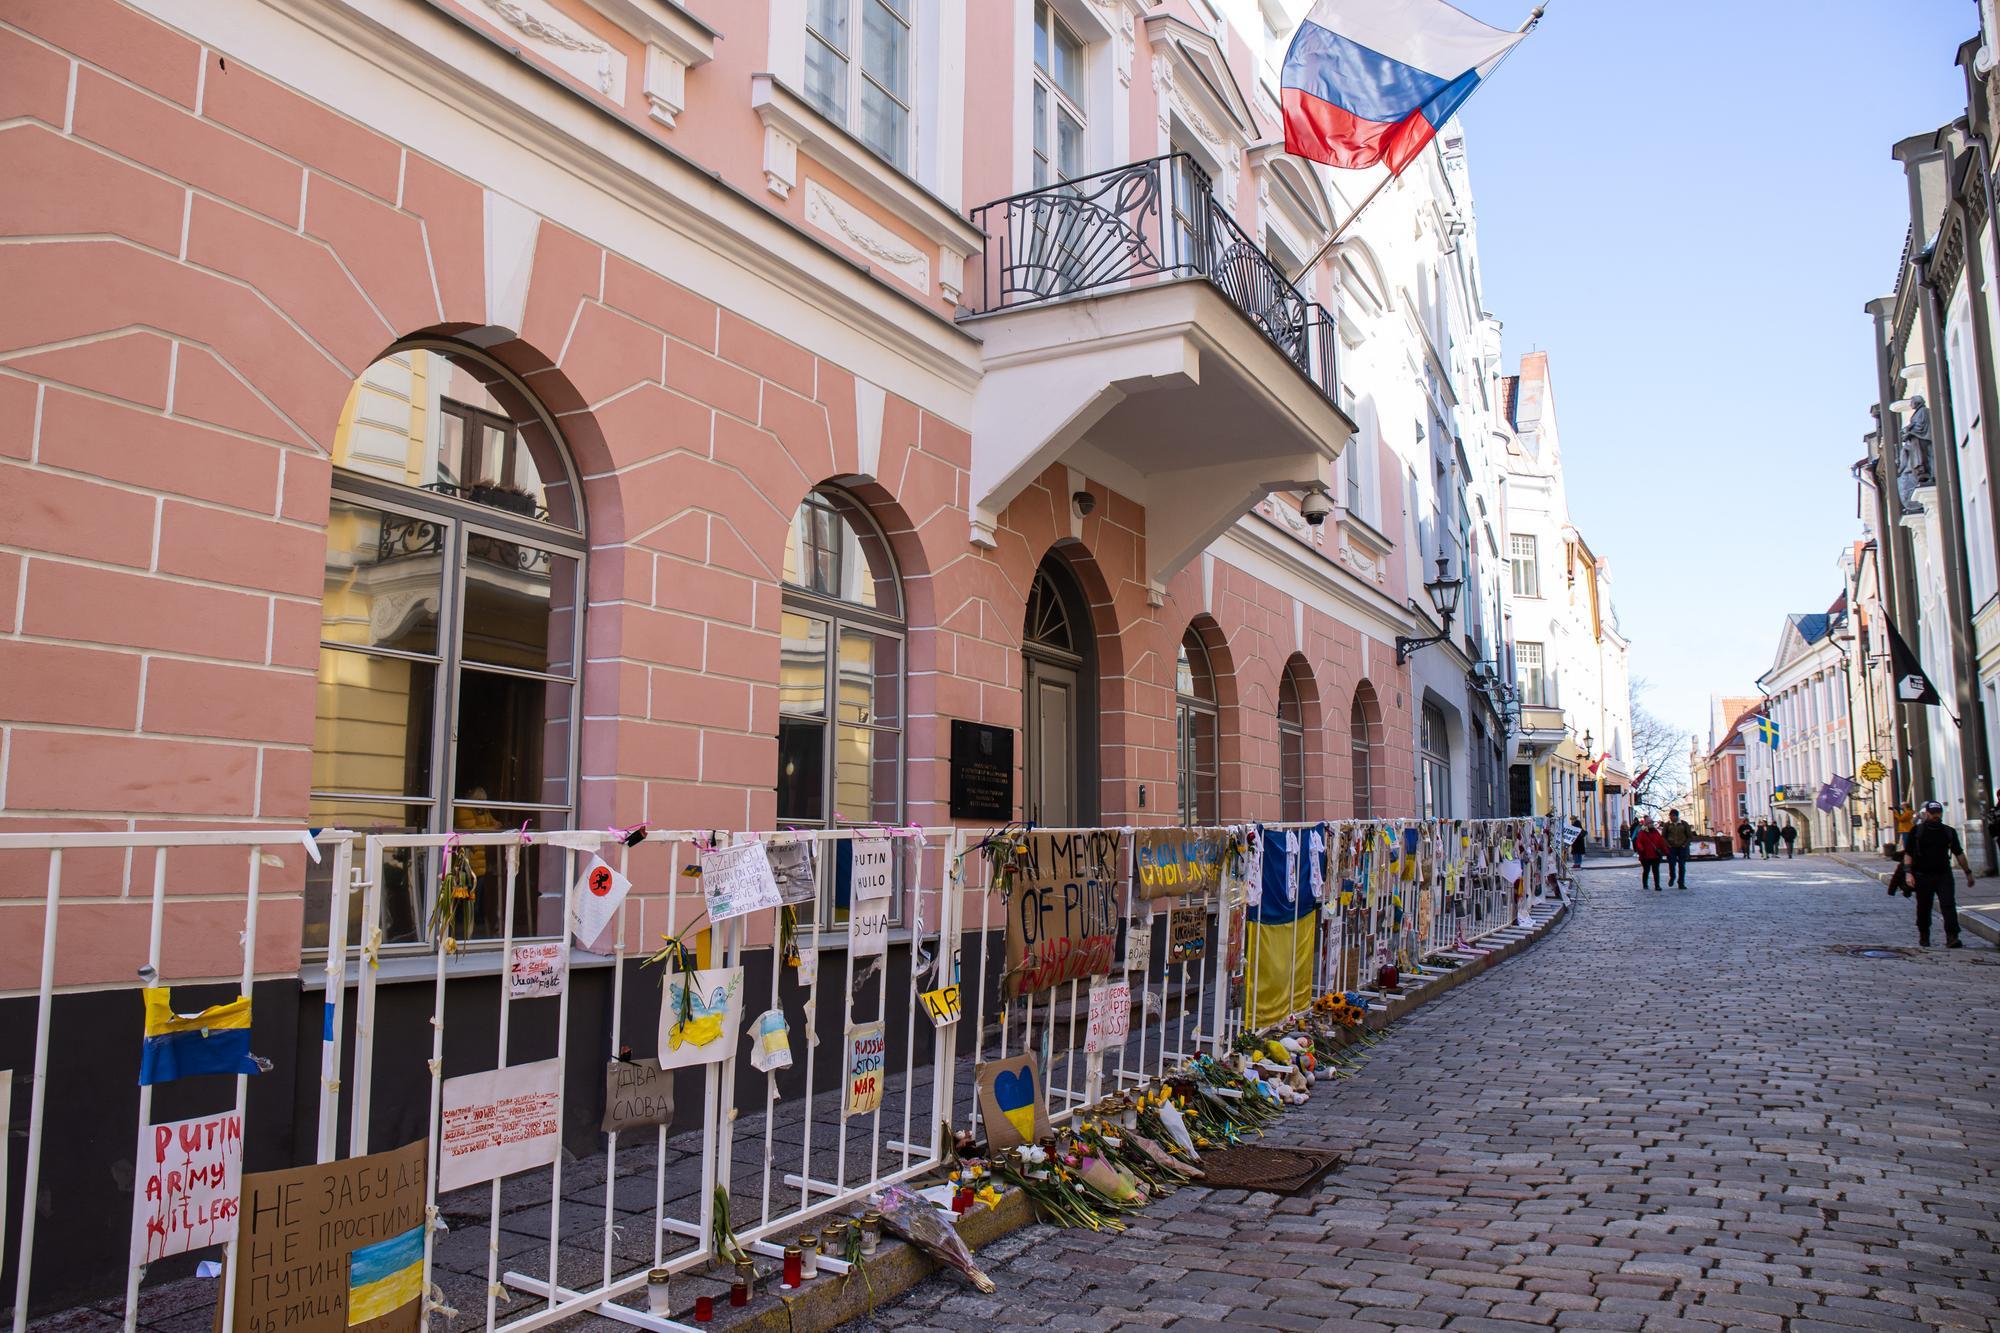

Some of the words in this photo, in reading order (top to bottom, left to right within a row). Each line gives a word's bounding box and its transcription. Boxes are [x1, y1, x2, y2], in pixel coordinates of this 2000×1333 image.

[855, 852, 886, 866] PUTIN
[1051, 831, 1121, 881] MEMORY
[858, 874, 885, 888] HUILO
[1021, 887, 1053, 944] OF
[1091, 1008, 1099, 1020] IS
[855, 1038, 884, 1055] RUSSIA
[853, 1056, 880, 1075] STOP
[855, 1077, 875, 1096] WAR
[613, 1095, 667, 1121] СЛОВА
[155, 1116, 241, 1162] PUTIN
[146, 1162, 225, 1201] ARMY
[252, 1182, 304, 1234] НЕ
[319, 1158, 427, 1215] ЗАБУДЕ
[147, 1196, 239, 1240] KILLERS
[252, 1232, 300, 1273] НЕ
[319, 1197, 419, 1251] ПРОСТИМ!
